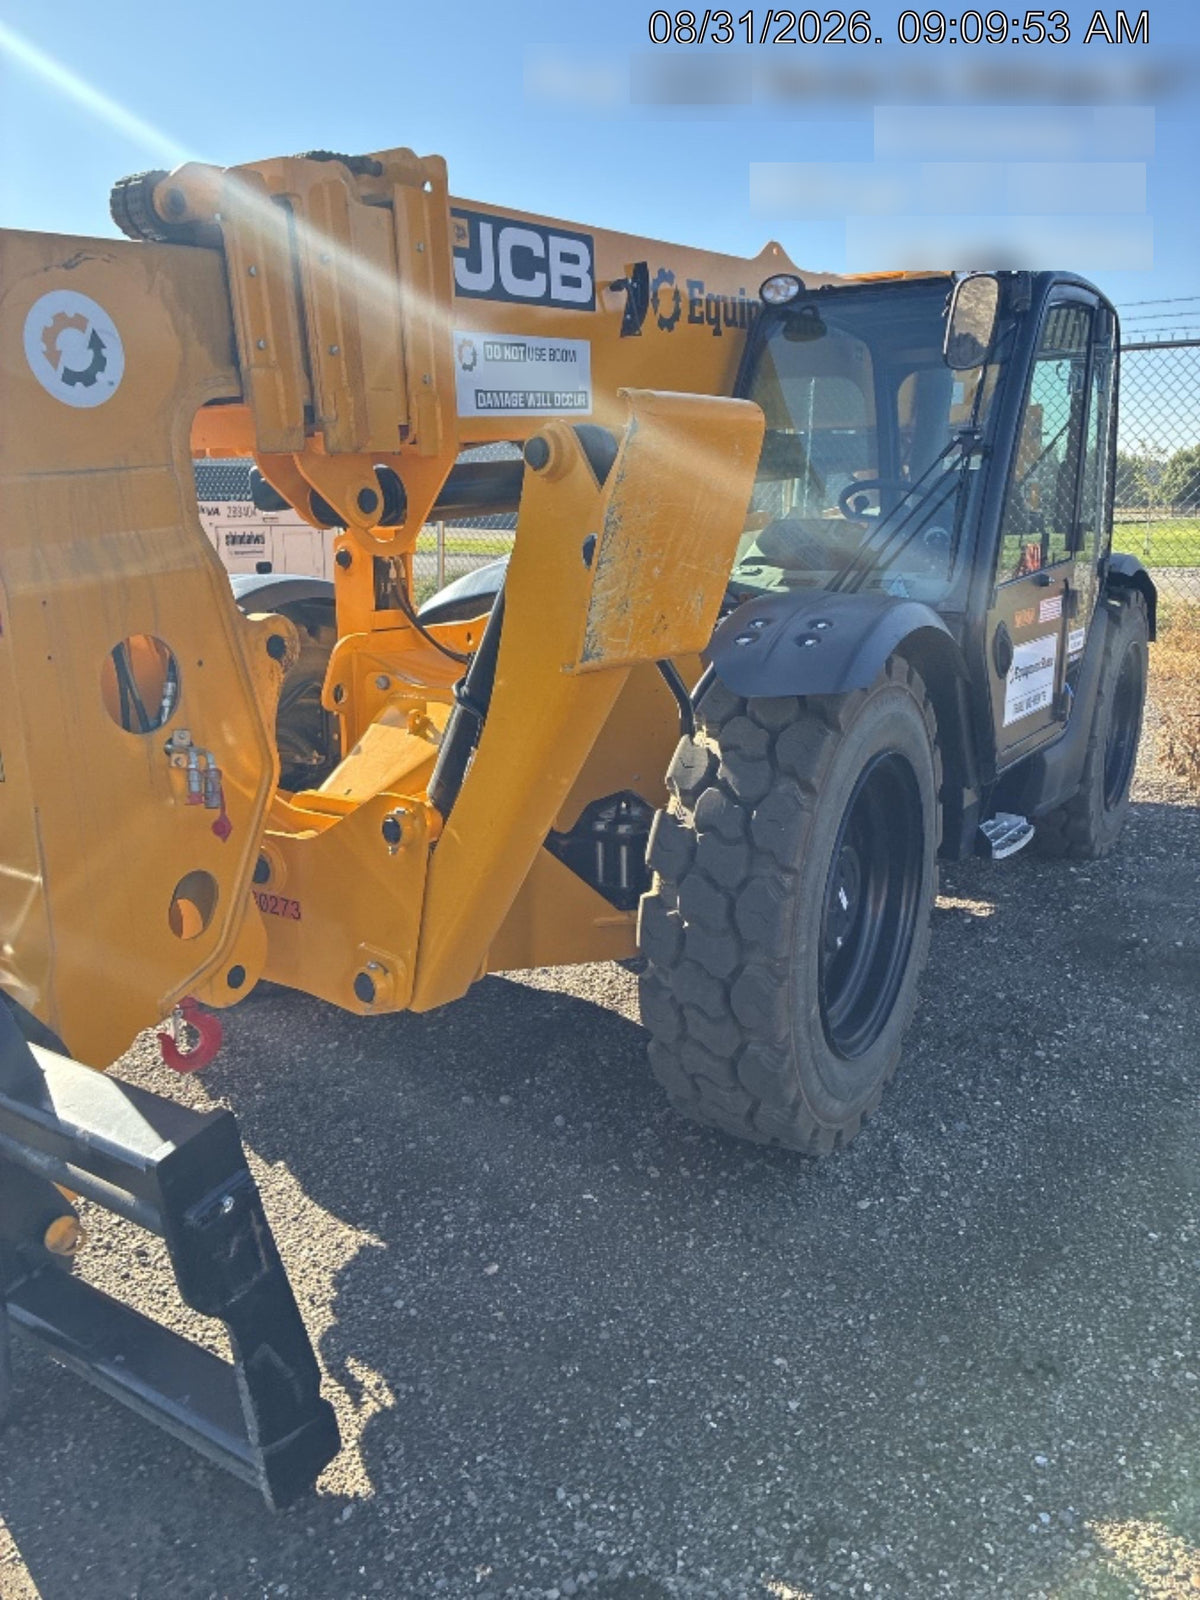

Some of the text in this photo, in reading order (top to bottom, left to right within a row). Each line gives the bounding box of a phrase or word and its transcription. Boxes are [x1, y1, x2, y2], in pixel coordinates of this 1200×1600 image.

[453, 221, 593, 304] JCB
[485, 344, 502, 360] DO
[504, 345, 525, 361] NOT
[527, 346, 547, 362] USE
[478, 391, 587, 408] DAMAGE WILL OCCUR
[252, 890, 302, 920] 0273
